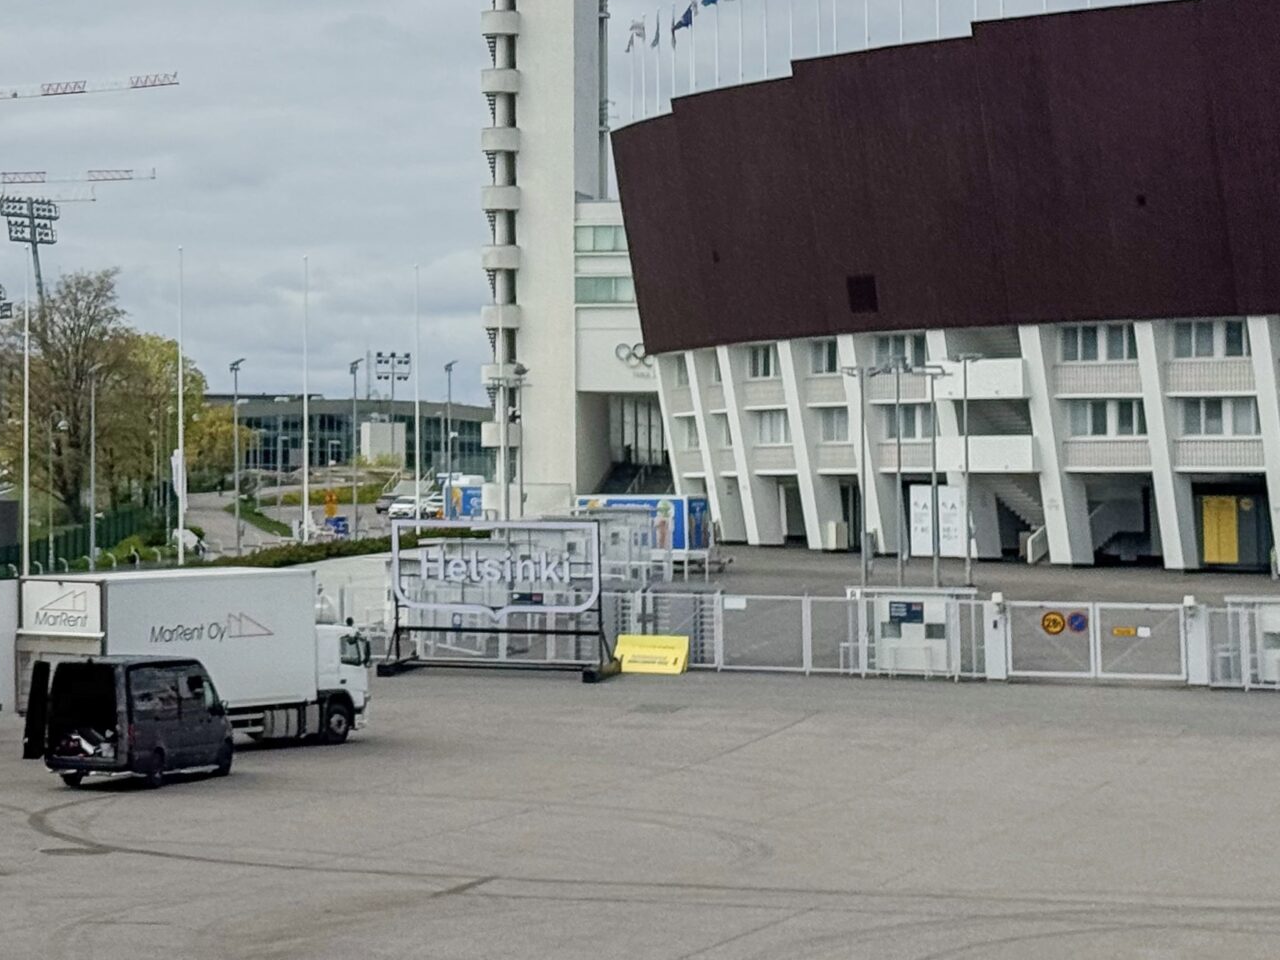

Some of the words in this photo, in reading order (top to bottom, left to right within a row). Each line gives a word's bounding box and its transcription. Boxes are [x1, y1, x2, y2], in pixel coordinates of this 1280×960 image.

[420, 549, 570, 583] Helsinki
[35, 612, 88, 627] MarRent
[150, 622, 205, 643] MarRent
[208, 622, 227, 642] Oy
